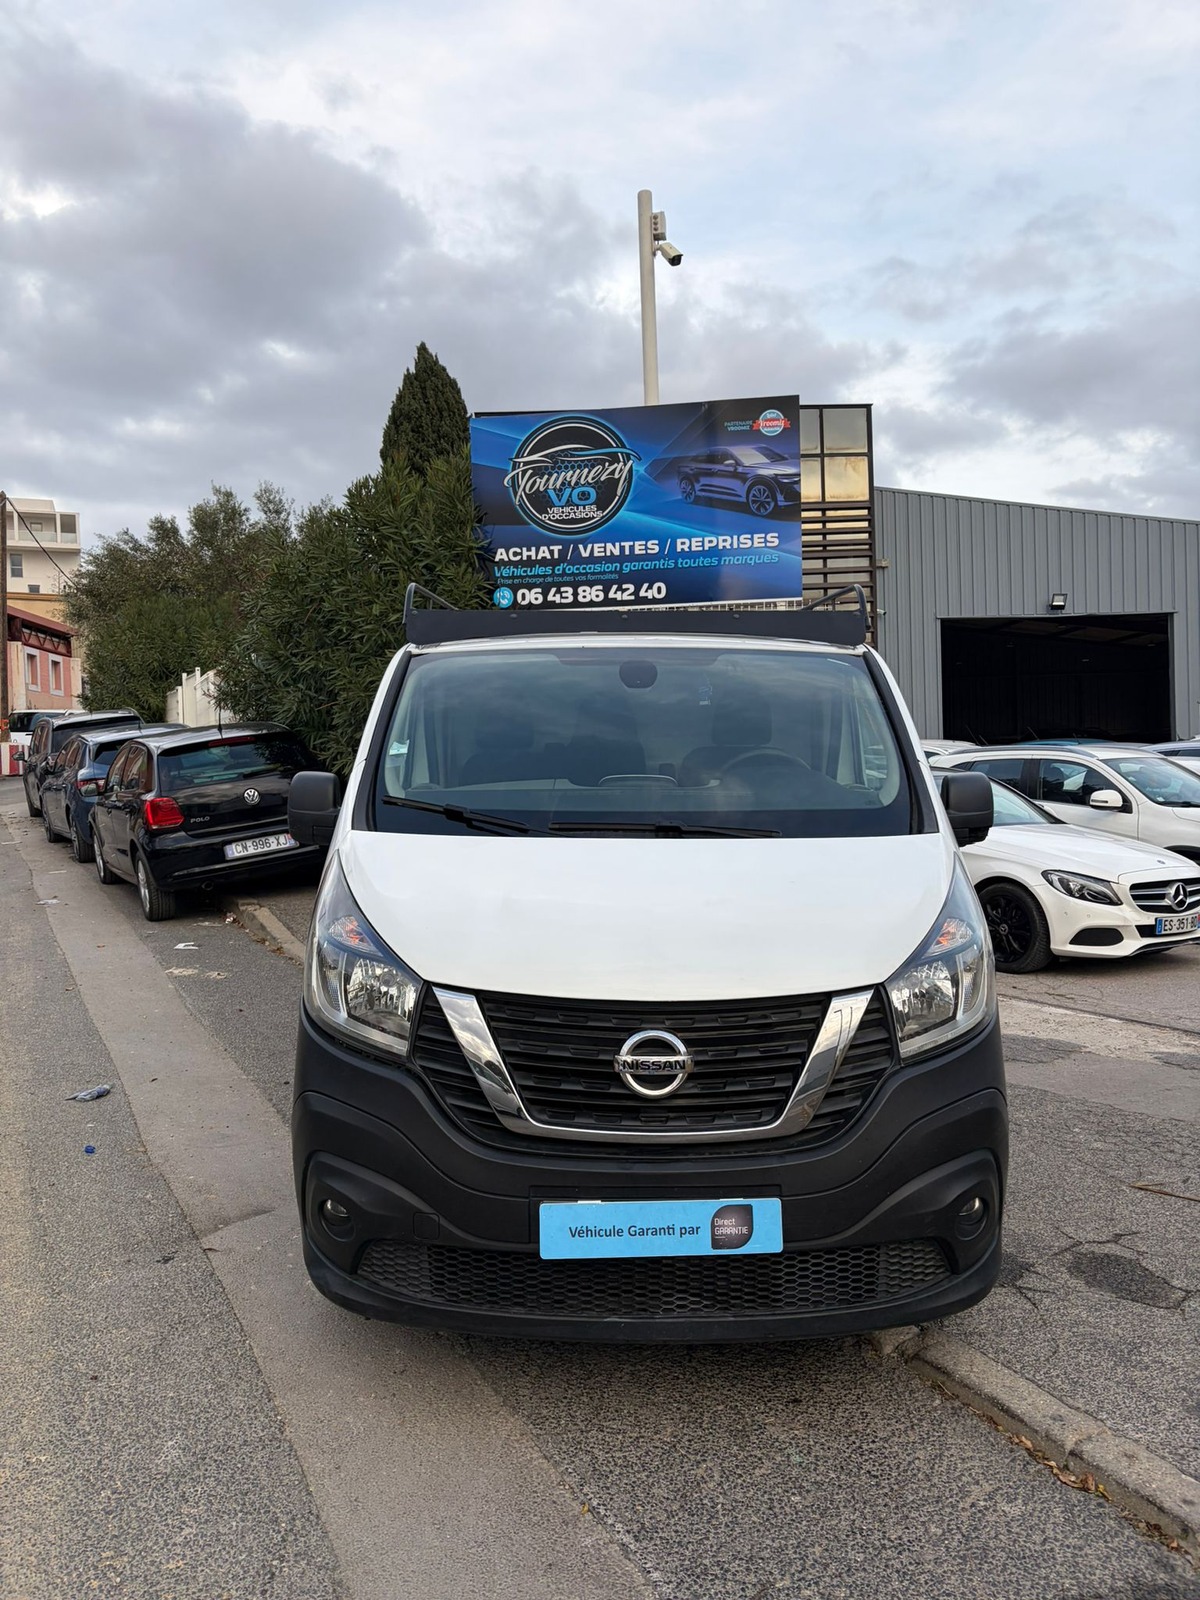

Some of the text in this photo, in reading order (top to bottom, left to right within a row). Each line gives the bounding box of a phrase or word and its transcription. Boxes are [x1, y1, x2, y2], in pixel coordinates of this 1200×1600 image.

[504, 460, 633, 505] Tournezy
[546, 486, 597, 506] VO
[541, 511, 603, 520] D'OCCASIONS
[547, 505, 597, 514] VEHICULES
[494, 545, 562, 561] ACHAT
[578, 540, 660, 557] VENTES
[676, 533, 779, 552] REPRISES
[494, 554, 779, 577] Véhicules d'occasion garantis toutes marques
[522, 577, 544, 585] charge
[587, 573, 619, 581] formalités
[517, 582, 666, 605] 06 43 86 42 40
[234, 835, 288, 854] CN-996-XJ
[622, 1060, 686, 1071] NISSAN
[714, 1217, 736, 1226] Direct
[569, 1224, 701, 1238] Véhicule Garanti par
[714, 1226, 749, 1235] GARANTIE
